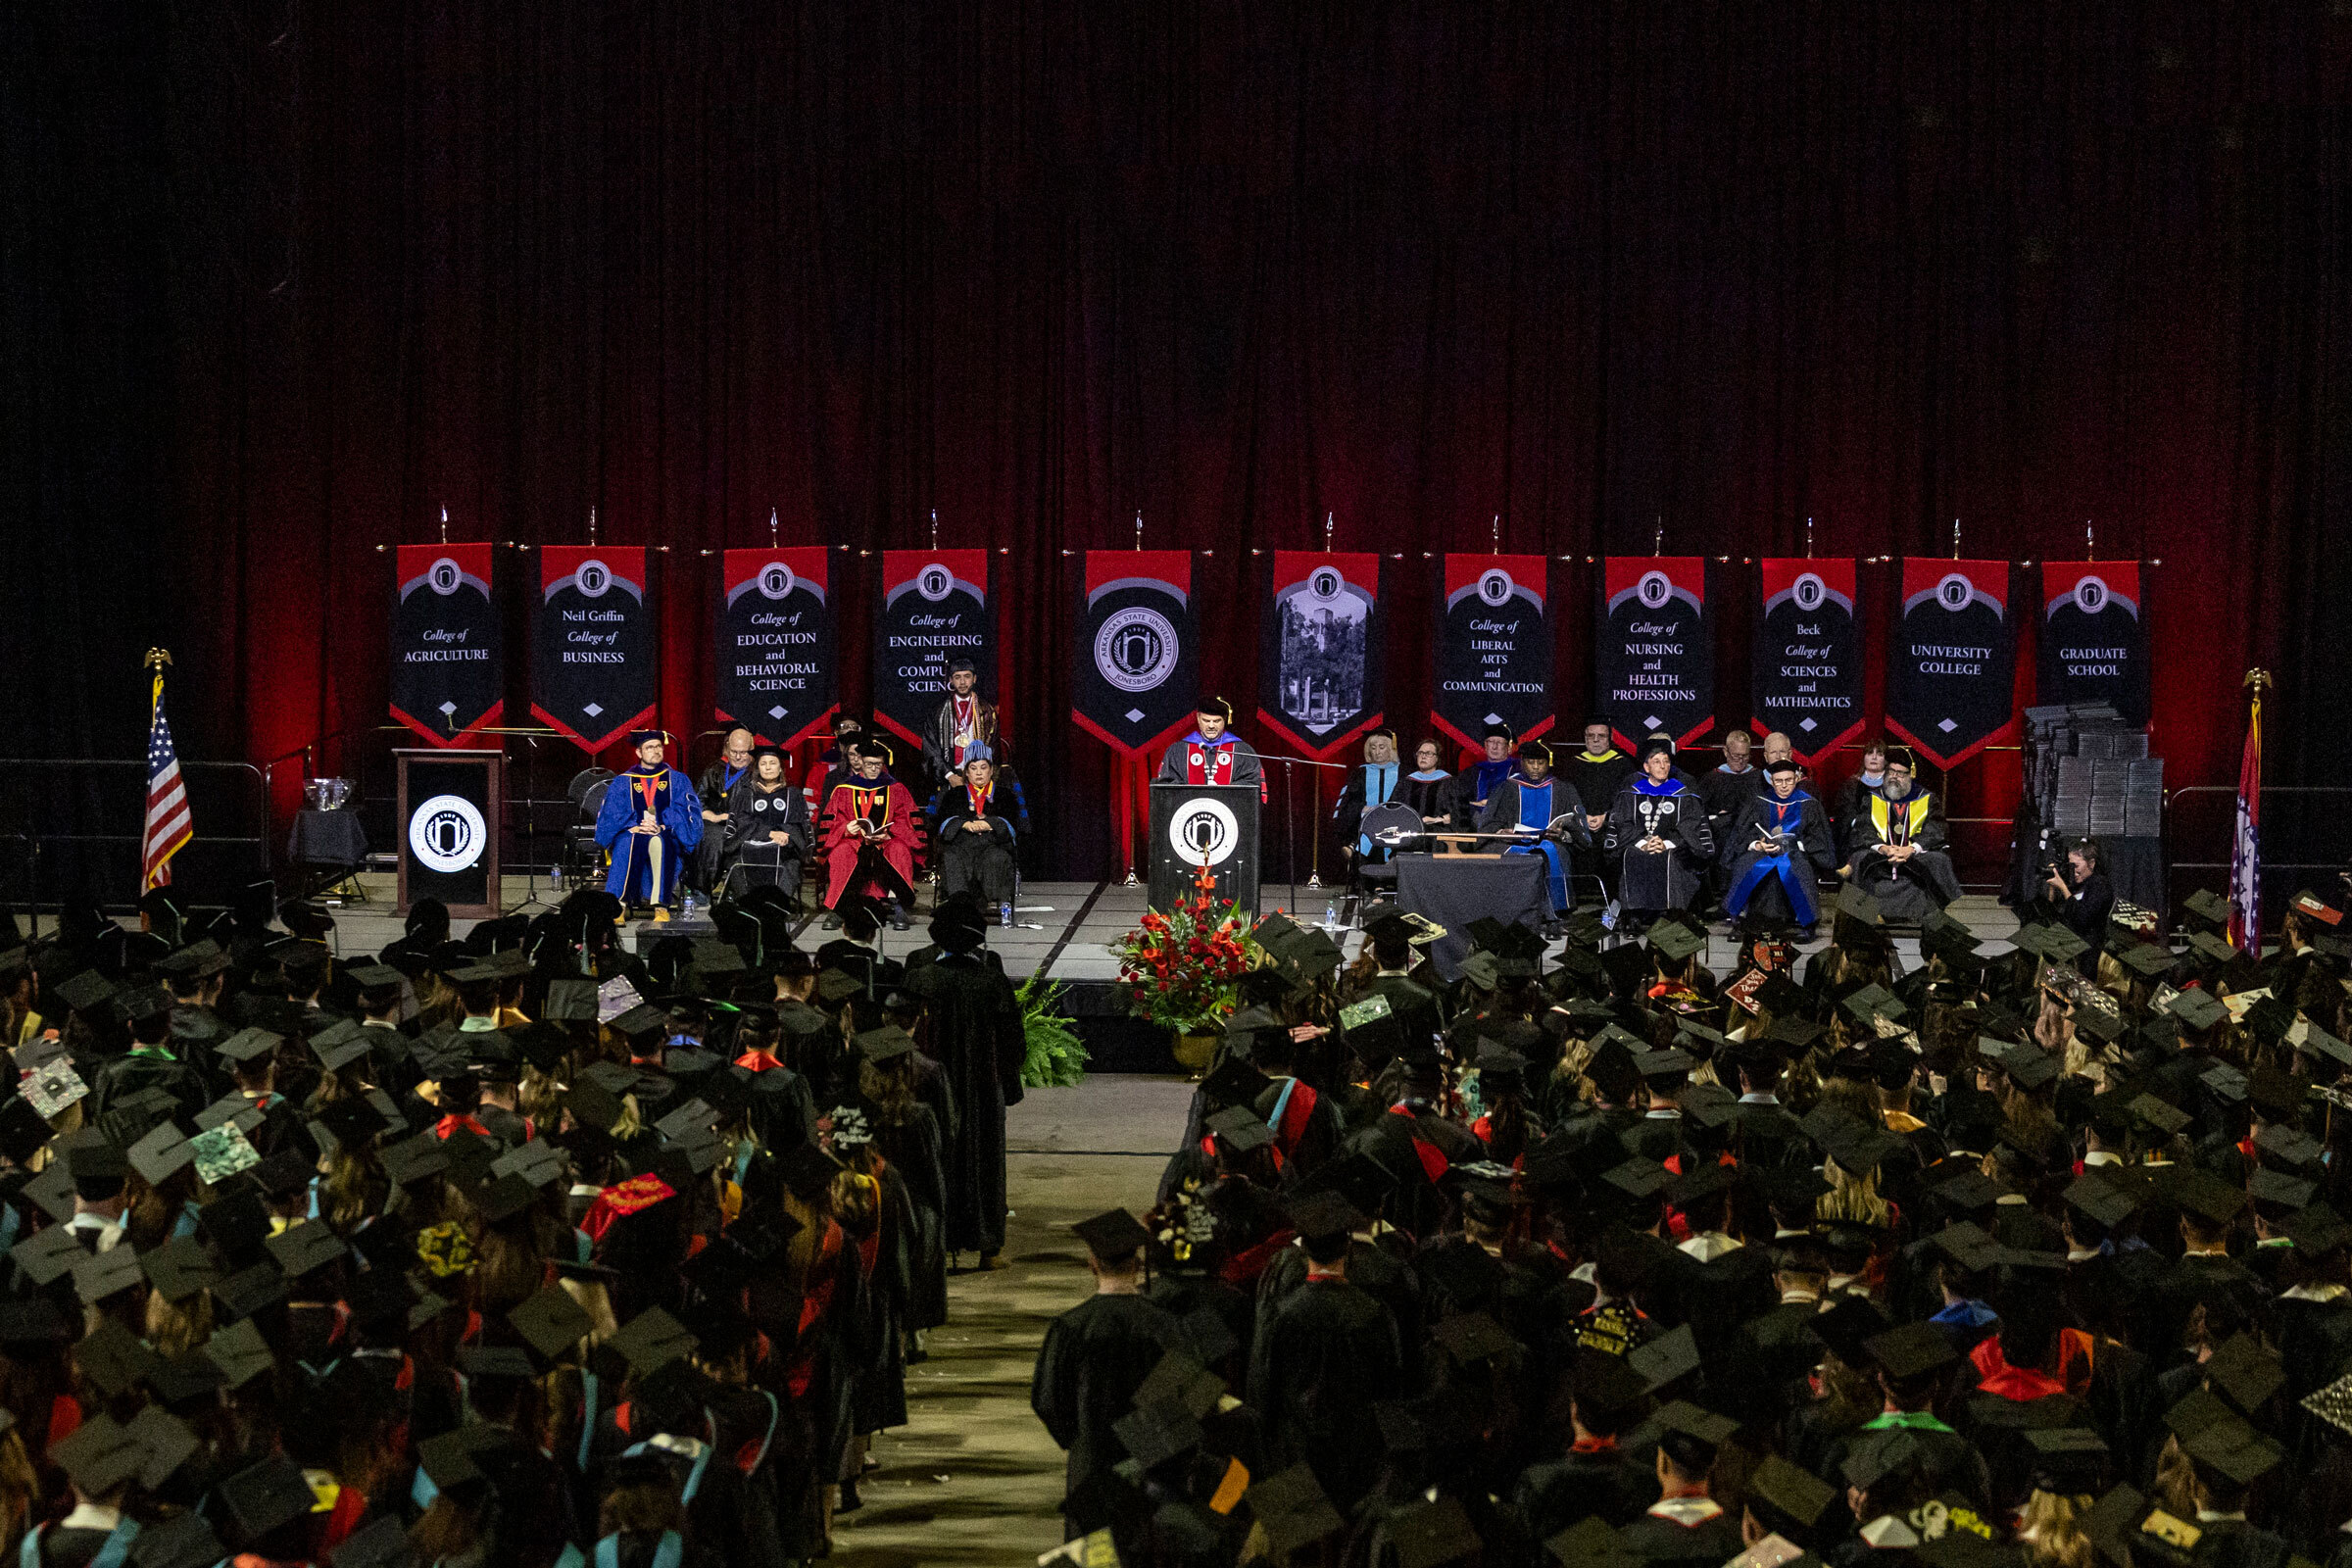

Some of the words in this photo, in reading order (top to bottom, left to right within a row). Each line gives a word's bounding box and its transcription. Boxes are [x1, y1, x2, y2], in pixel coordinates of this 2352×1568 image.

[563, 611, 585, 621] Neil
[589, 611, 624, 621] Griffin
[751, 613, 787, 626] College
[790, 612, 802, 625] of
[909, 614, 946, 628] College
[948, 614, 960, 628] of
[1470, 619, 1504, 634] College
[1506, 620, 1519, 634] of
[1630, 622, 1664, 636] College
[1666, 622, 1679, 636] of
[1796, 624, 1820, 635] Beck
[423, 629, 456, 643] College
[457, 628, 468, 642] of
[567, 631, 604, 645] College
[606, 631, 618, 645] of
[737, 633, 816, 646] EDUCATION
[889, 635, 983, 647] ENGINEERING
[1102, 619, 1122, 657] ARKANSAS
[1149, 617, 1171, 657] UNIVERSITY
[1471, 640, 1515, 651] LIBERAL
[1625, 644, 1684, 655] NURSING
[404, 650, 489, 662] AGRICULTURE
[563, 653, 624, 663] BUSINESS
[765, 649, 785, 660] and
[924, 651, 944, 662] and
[1785, 645, 1818, 659] College
[1819, 645, 1832, 659] of
[1911, 645, 1991, 660] UNIVERSITY
[2060, 648, 2127, 660] GRADUATE
[1480, 655, 1507, 664] ARTS
[1642, 659, 1661, 670] and
[736, 663, 819, 676] BEHAVIORAL
[898, 665, 947, 677] COMPU
[1484, 668, 1501, 678] and
[1781, 666, 1837, 677] SCIENCES
[1920, 662, 1982, 675] COLLEGE
[2068, 664, 2120, 676] SCHOOL
[750, 678, 806, 691] SCIENCE
[1115, 673, 1156, 685] JONESBORO
[1629, 674, 1679, 685] HEALTH
[907, 680, 956, 692] SCIENC
[1443, 681, 1544, 693] COMMUNICATION
[1798, 681, 1816, 693] and
[1613, 690, 1695, 701] PROFESSIONS
[1765, 696, 1850, 708] MATHEMATICS
